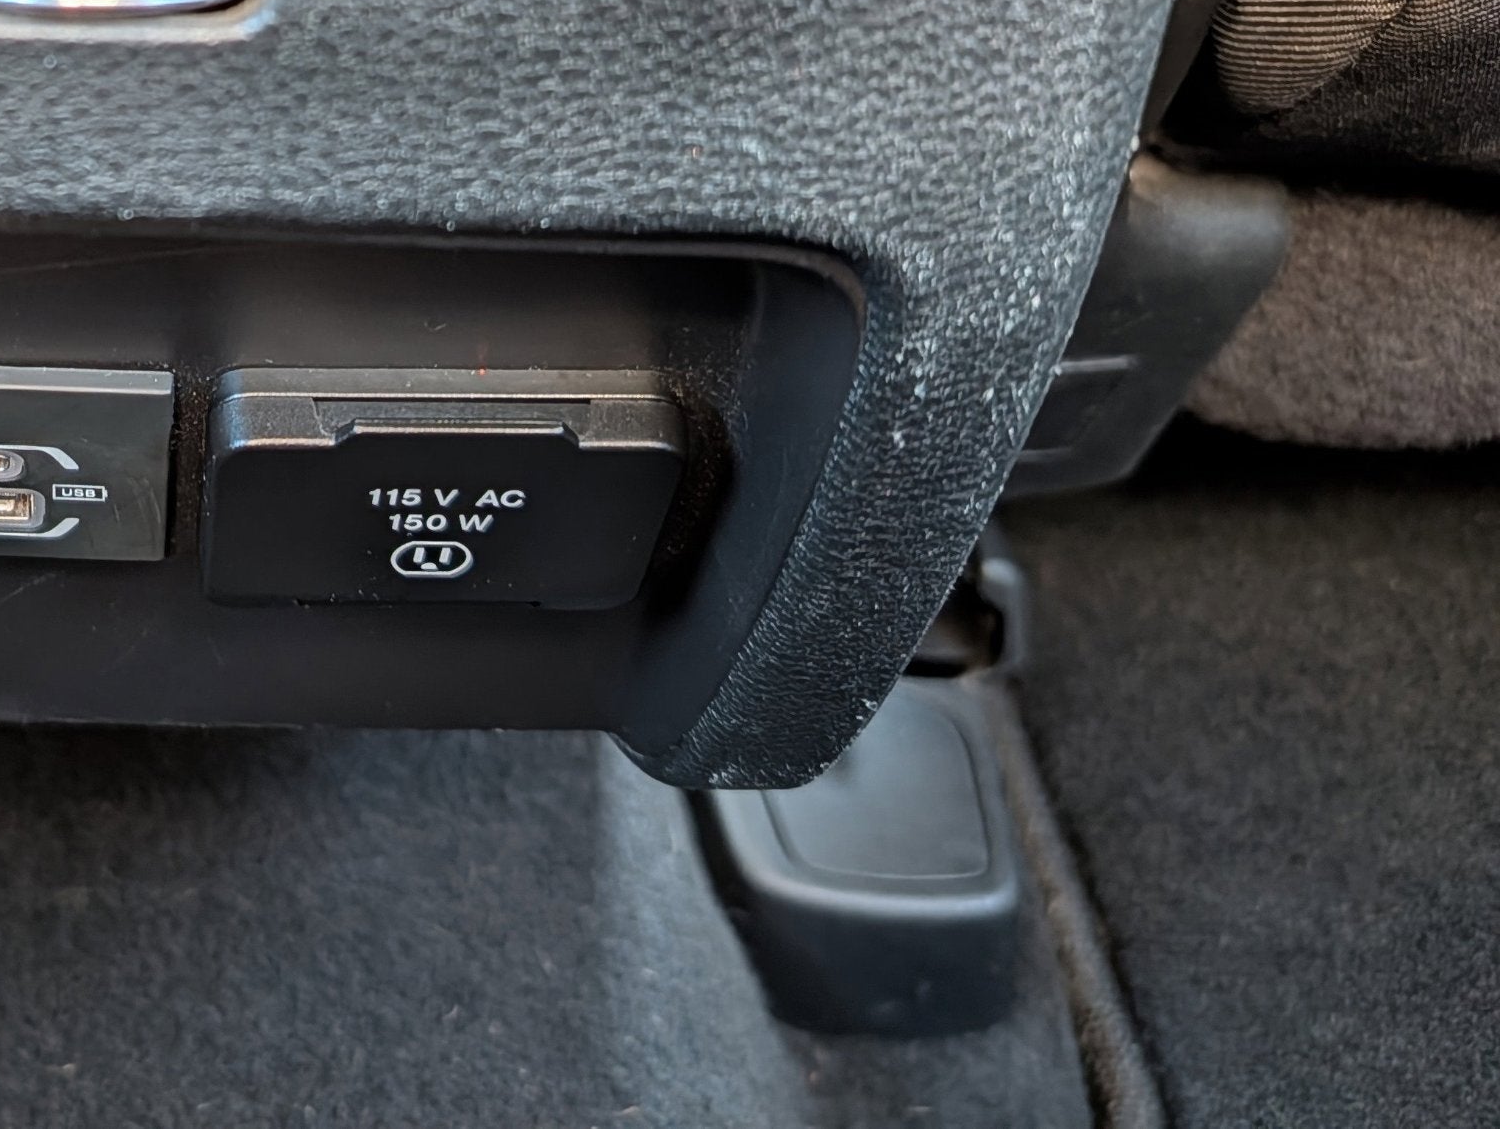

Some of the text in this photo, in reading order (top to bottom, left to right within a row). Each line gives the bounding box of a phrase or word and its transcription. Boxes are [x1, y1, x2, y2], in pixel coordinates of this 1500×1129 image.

[61, 487, 96, 498] USB
[368, 488, 527, 508] 115 V AC
[389, 514, 494, 533] 150 W
